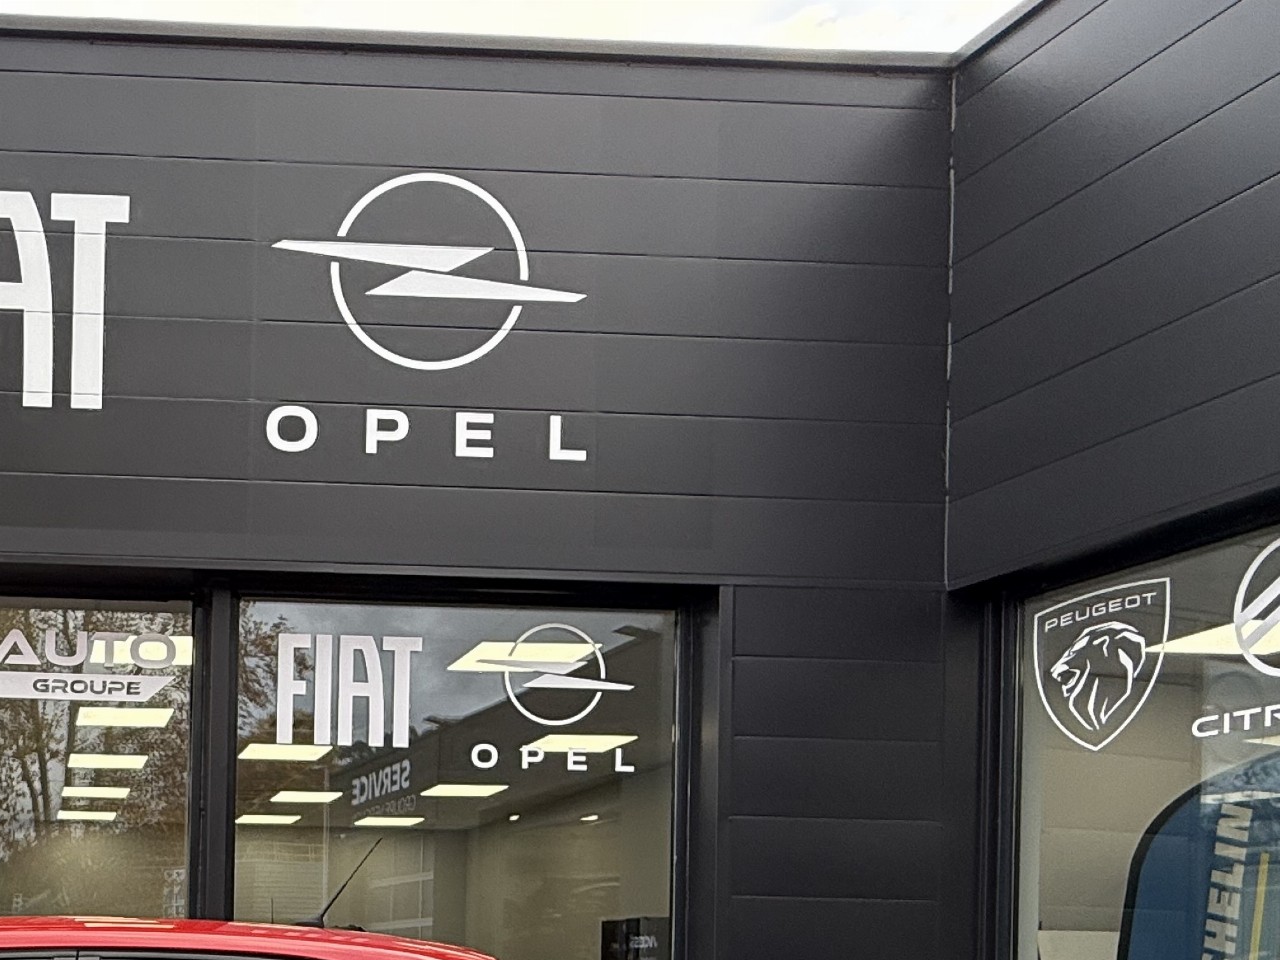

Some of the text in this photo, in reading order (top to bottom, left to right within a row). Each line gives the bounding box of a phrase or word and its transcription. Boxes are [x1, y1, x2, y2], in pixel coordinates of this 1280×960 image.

[265, 403, 588, 463] OPEL
[1044, 591, 1158, 634] PEUGEOT
[31, 677, 142, 696] GROUPE
[275, 632, 424, 749] FIAT
[470, 742, 636, 773] OPEL
